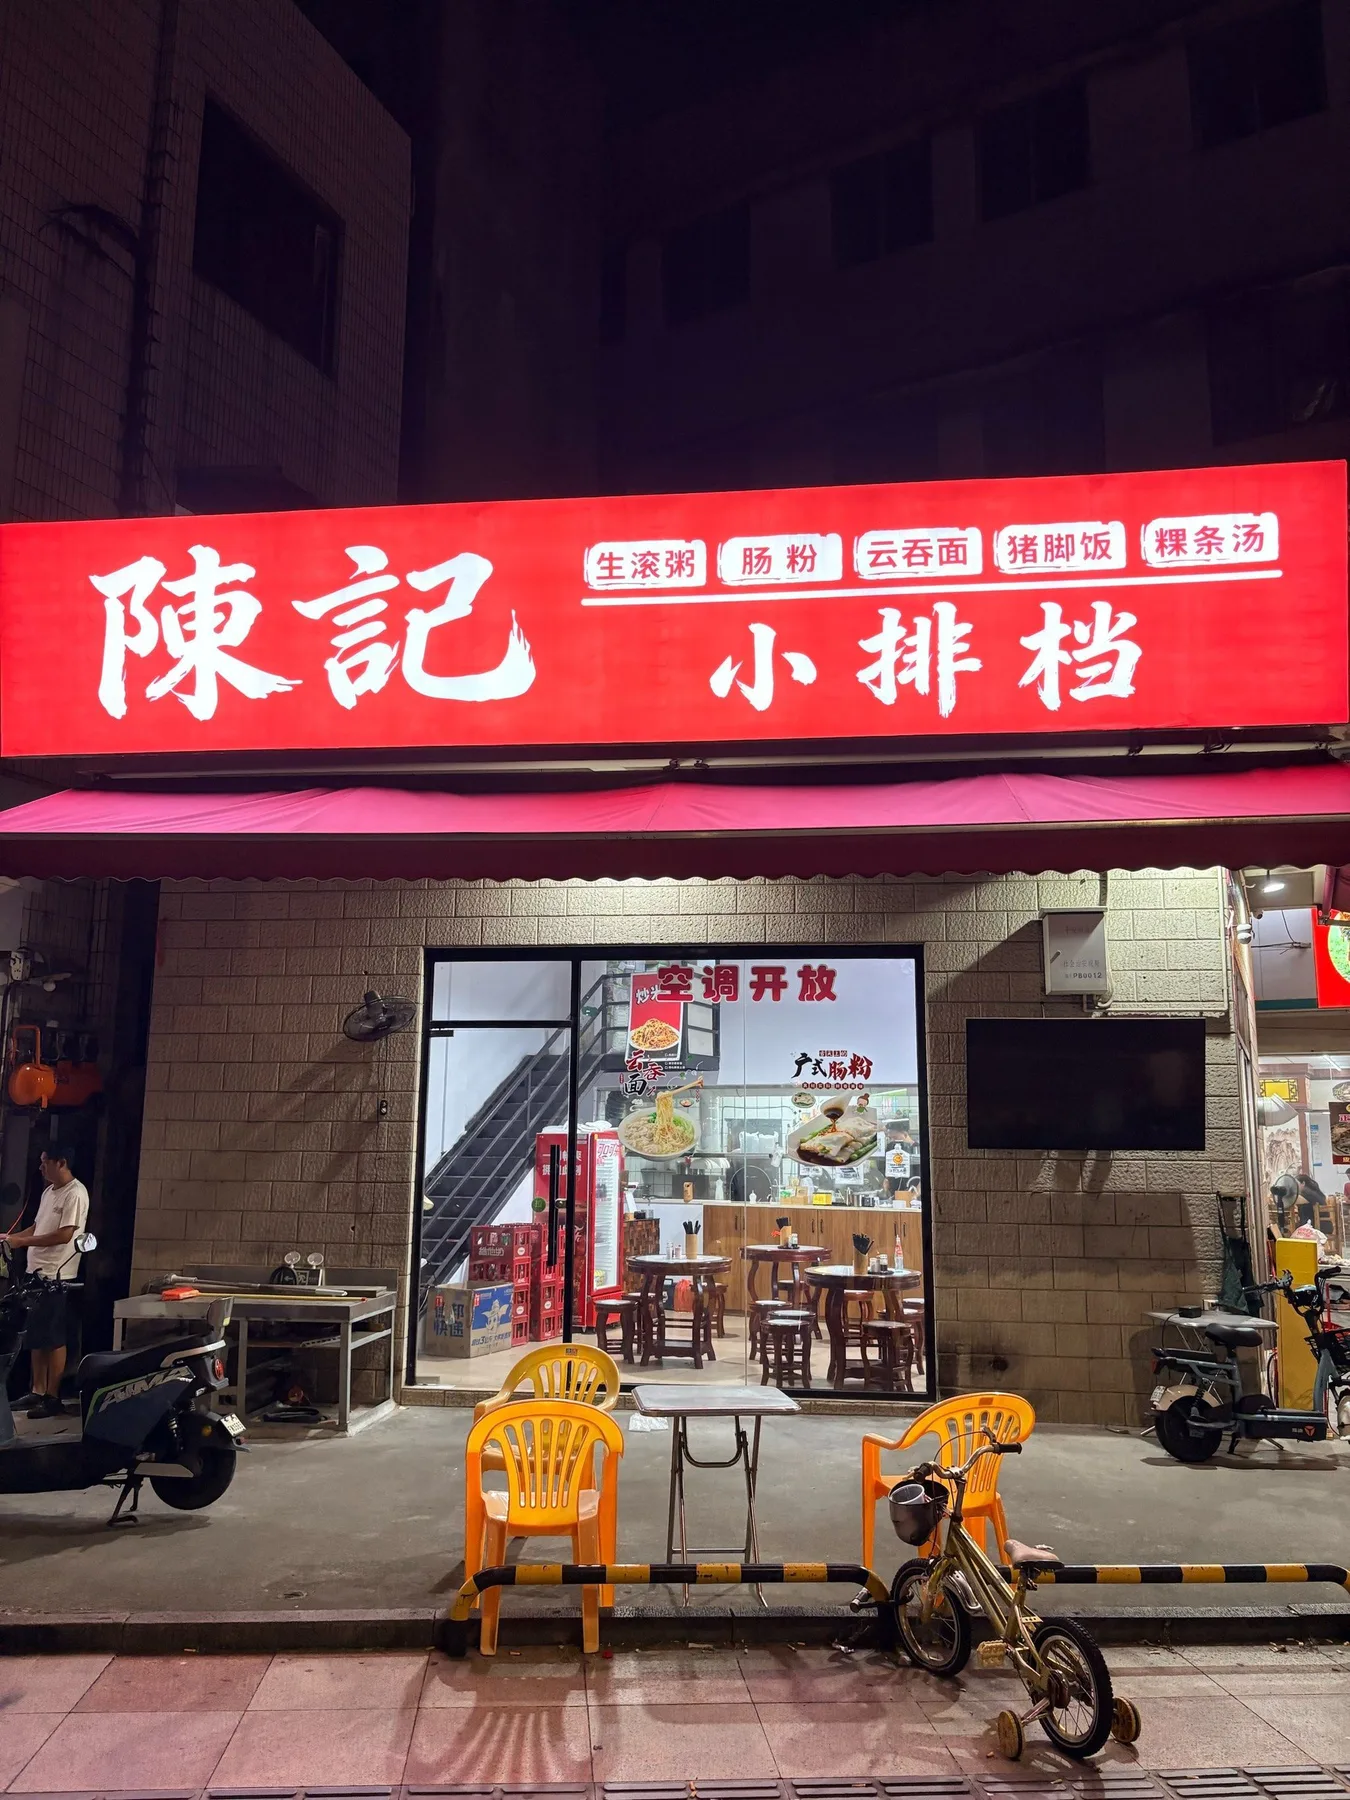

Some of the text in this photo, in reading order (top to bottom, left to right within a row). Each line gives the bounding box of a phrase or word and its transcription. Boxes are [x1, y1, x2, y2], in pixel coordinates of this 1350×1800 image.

[867, 537, 969, 569] 云吞面
[1007, 530, 1113, 565] 猪脚饭
[1154, 523, 1265, 557] 粿条汤
[596, 550, 695, 580] 生滚粥
[741, 543, 818, 576] 肠粉
[89, 545, 536, 721] 陳記
[710, 601, 1142, 719] 小排档
[658, 964, 838, 1003] 空调开放
[624, 1049, 667, 1096] 云吞面
[791, 1052, 874, 1081] 广式肠粉
